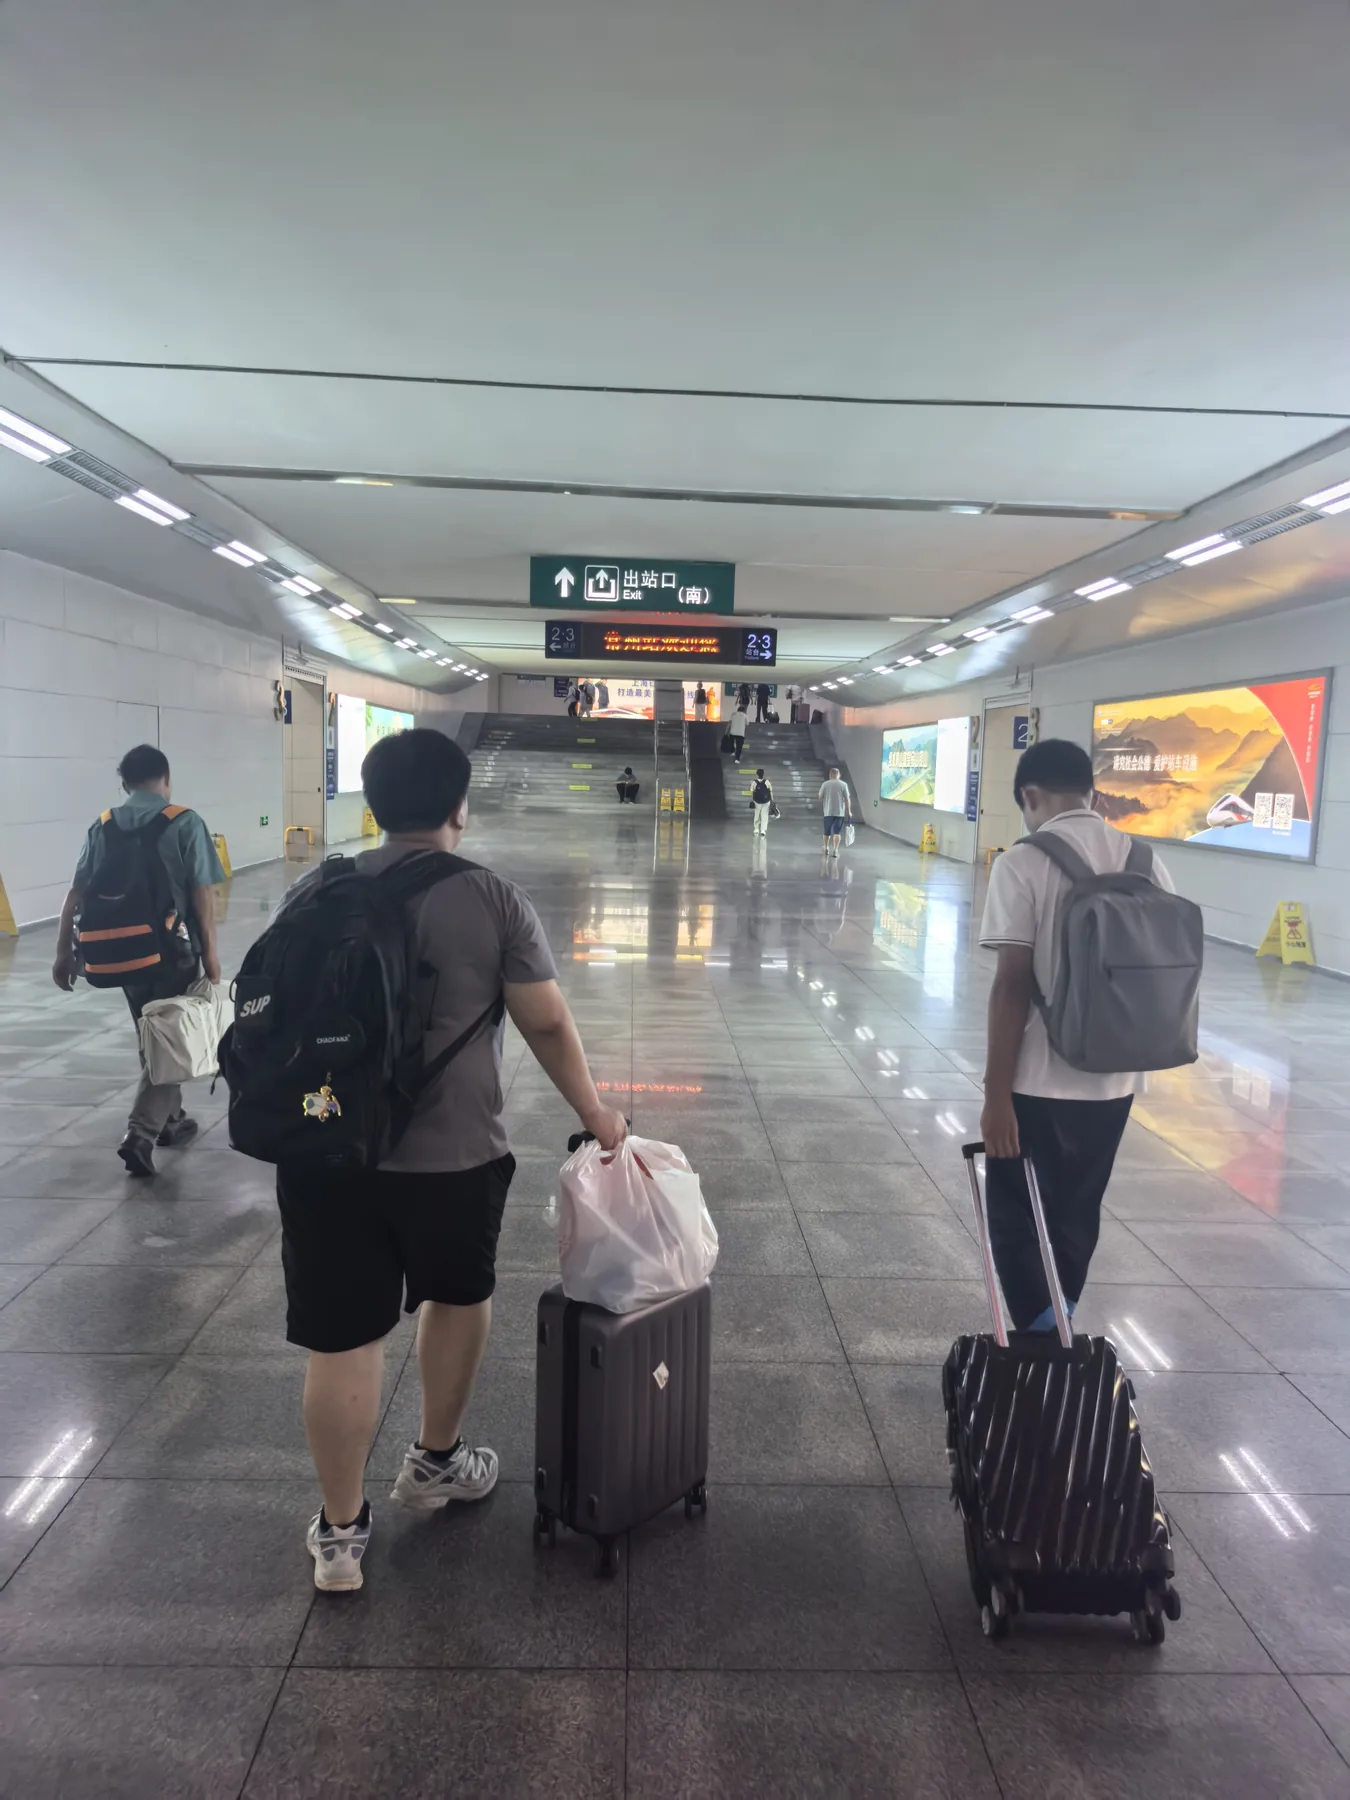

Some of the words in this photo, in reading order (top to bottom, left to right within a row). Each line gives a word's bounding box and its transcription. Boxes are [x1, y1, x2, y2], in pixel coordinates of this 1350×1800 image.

[623, 569, 676, 589] 出站口
[623, 589, 642, 600] Exit
[678, 586, 711, 604] (南)
[1017, 723, 1029, 743] 2
[240, 995, 271, 1017] SUP
